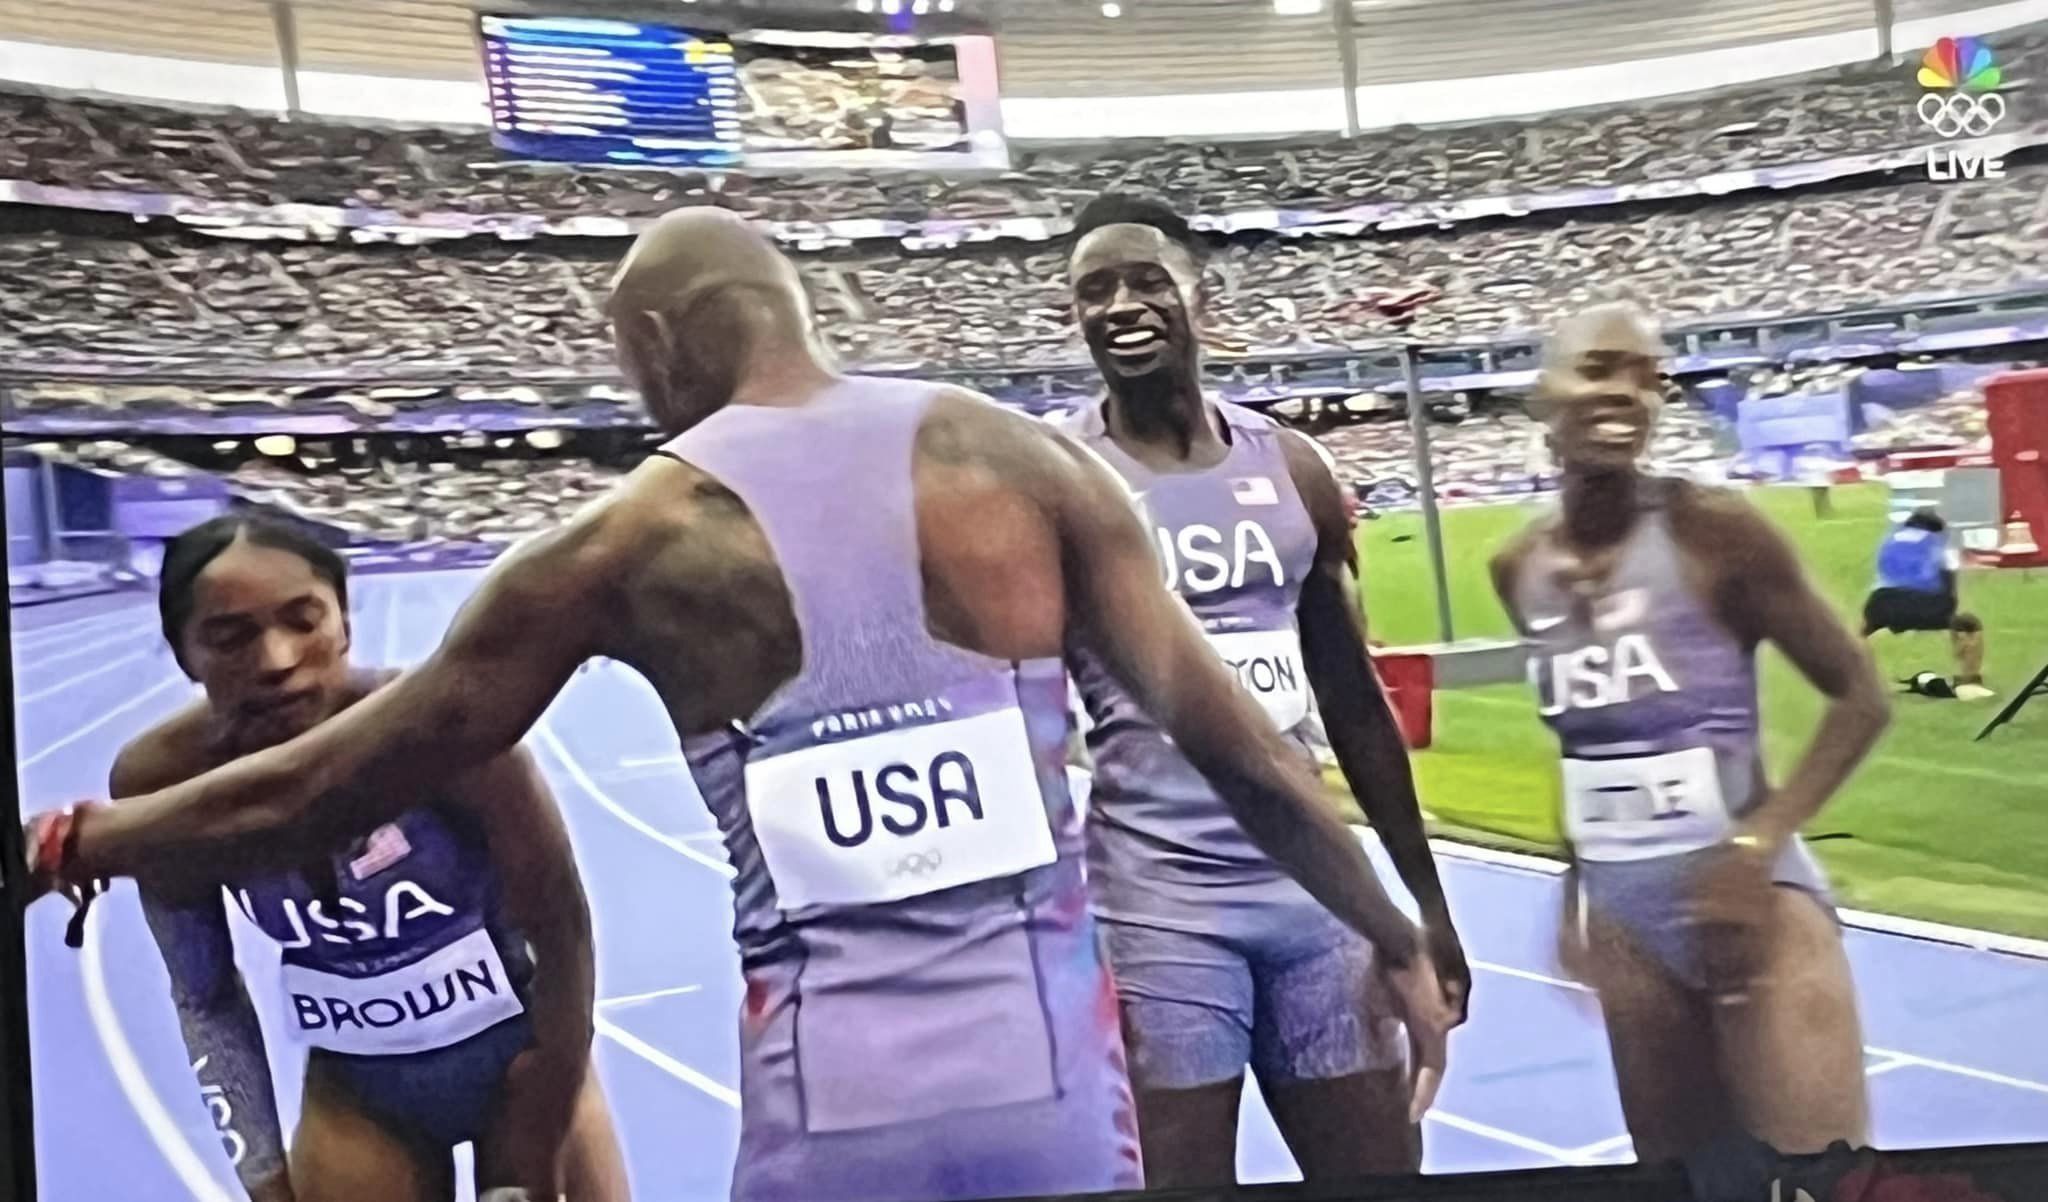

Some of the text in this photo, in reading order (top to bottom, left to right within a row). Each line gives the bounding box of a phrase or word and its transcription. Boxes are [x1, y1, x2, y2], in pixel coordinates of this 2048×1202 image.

[1527, 633, 1680, 716] USA
[814, 749, 984, 848] USA
[237, 880, 455, 948] USA
[291, 959, 498, 1034] BROWN
